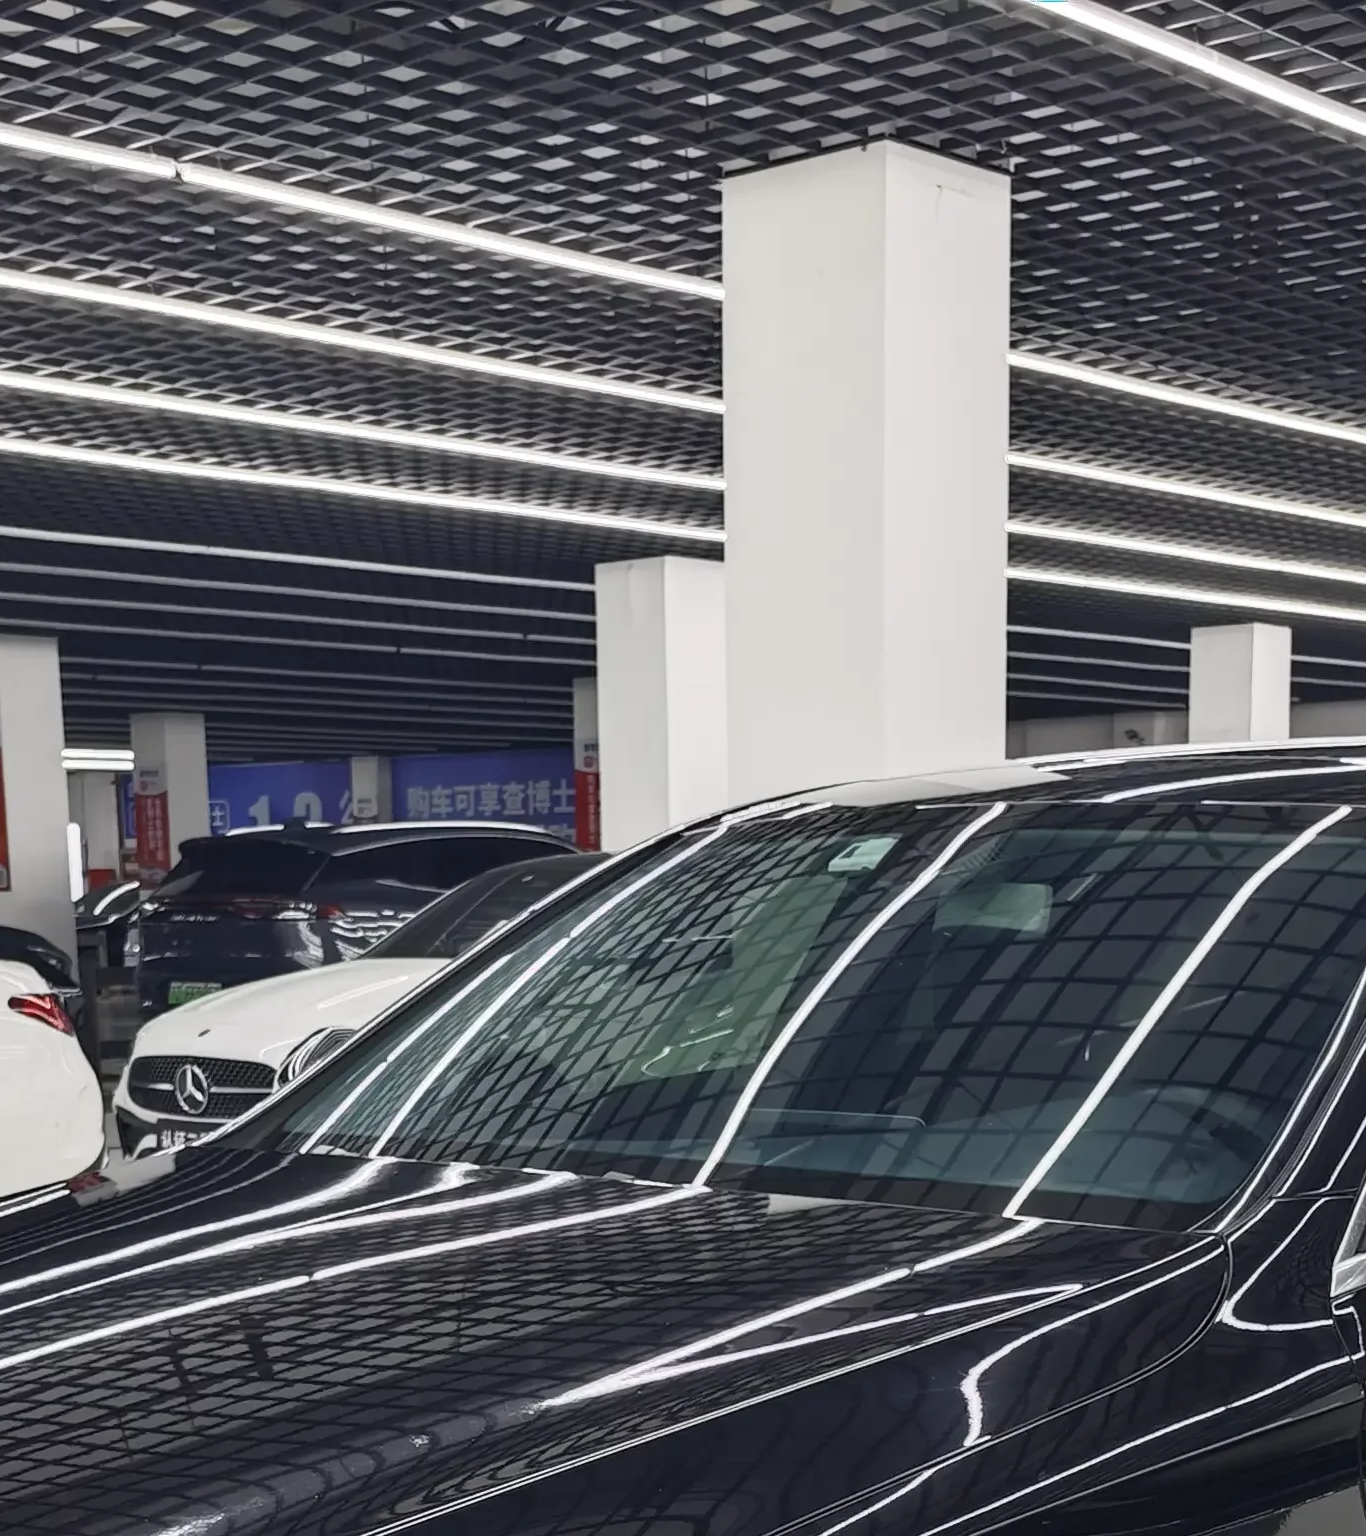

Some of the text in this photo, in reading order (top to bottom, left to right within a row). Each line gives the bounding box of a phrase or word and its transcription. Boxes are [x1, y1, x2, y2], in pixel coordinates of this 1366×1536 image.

[406, 778, 576, 819] 购车可享查博士
